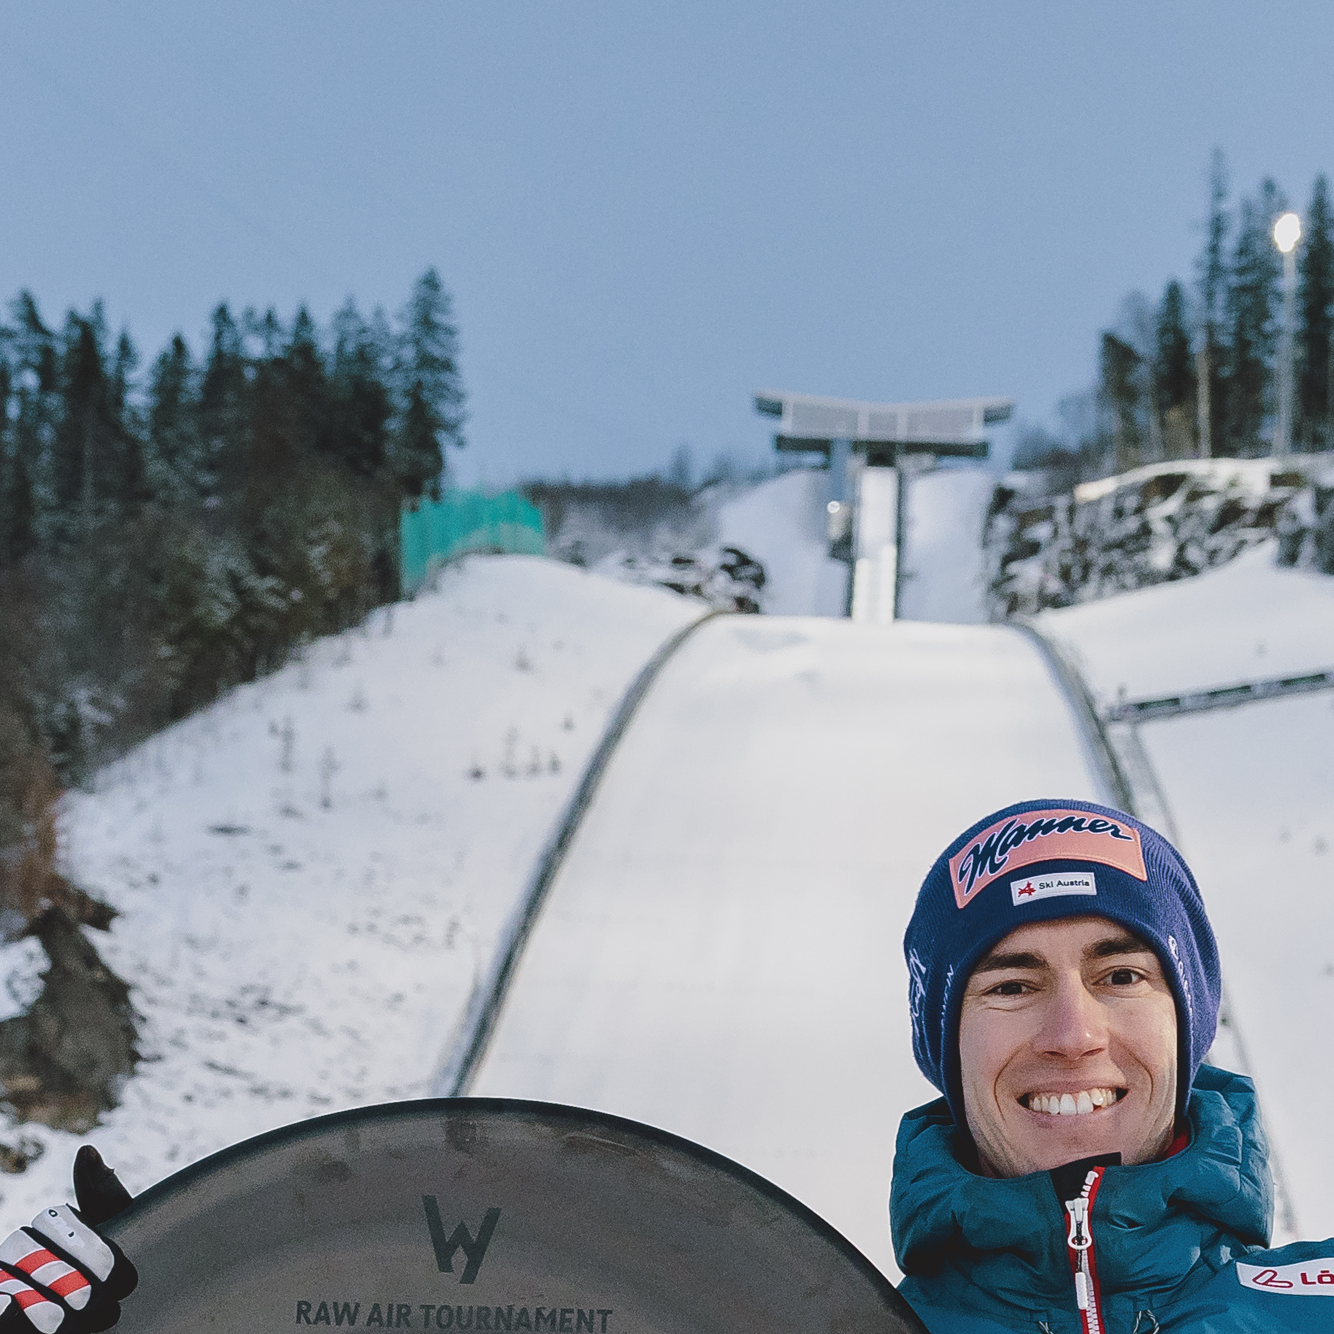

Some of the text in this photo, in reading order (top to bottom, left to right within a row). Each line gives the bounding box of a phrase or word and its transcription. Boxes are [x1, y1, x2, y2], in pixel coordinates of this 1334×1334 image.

[958, 815, 1134, 896] Manner
[1038, 879, 1090, 890] Ski Austria
[295, 1299, 613, 1334] RAW AIR TOURNAMENT
